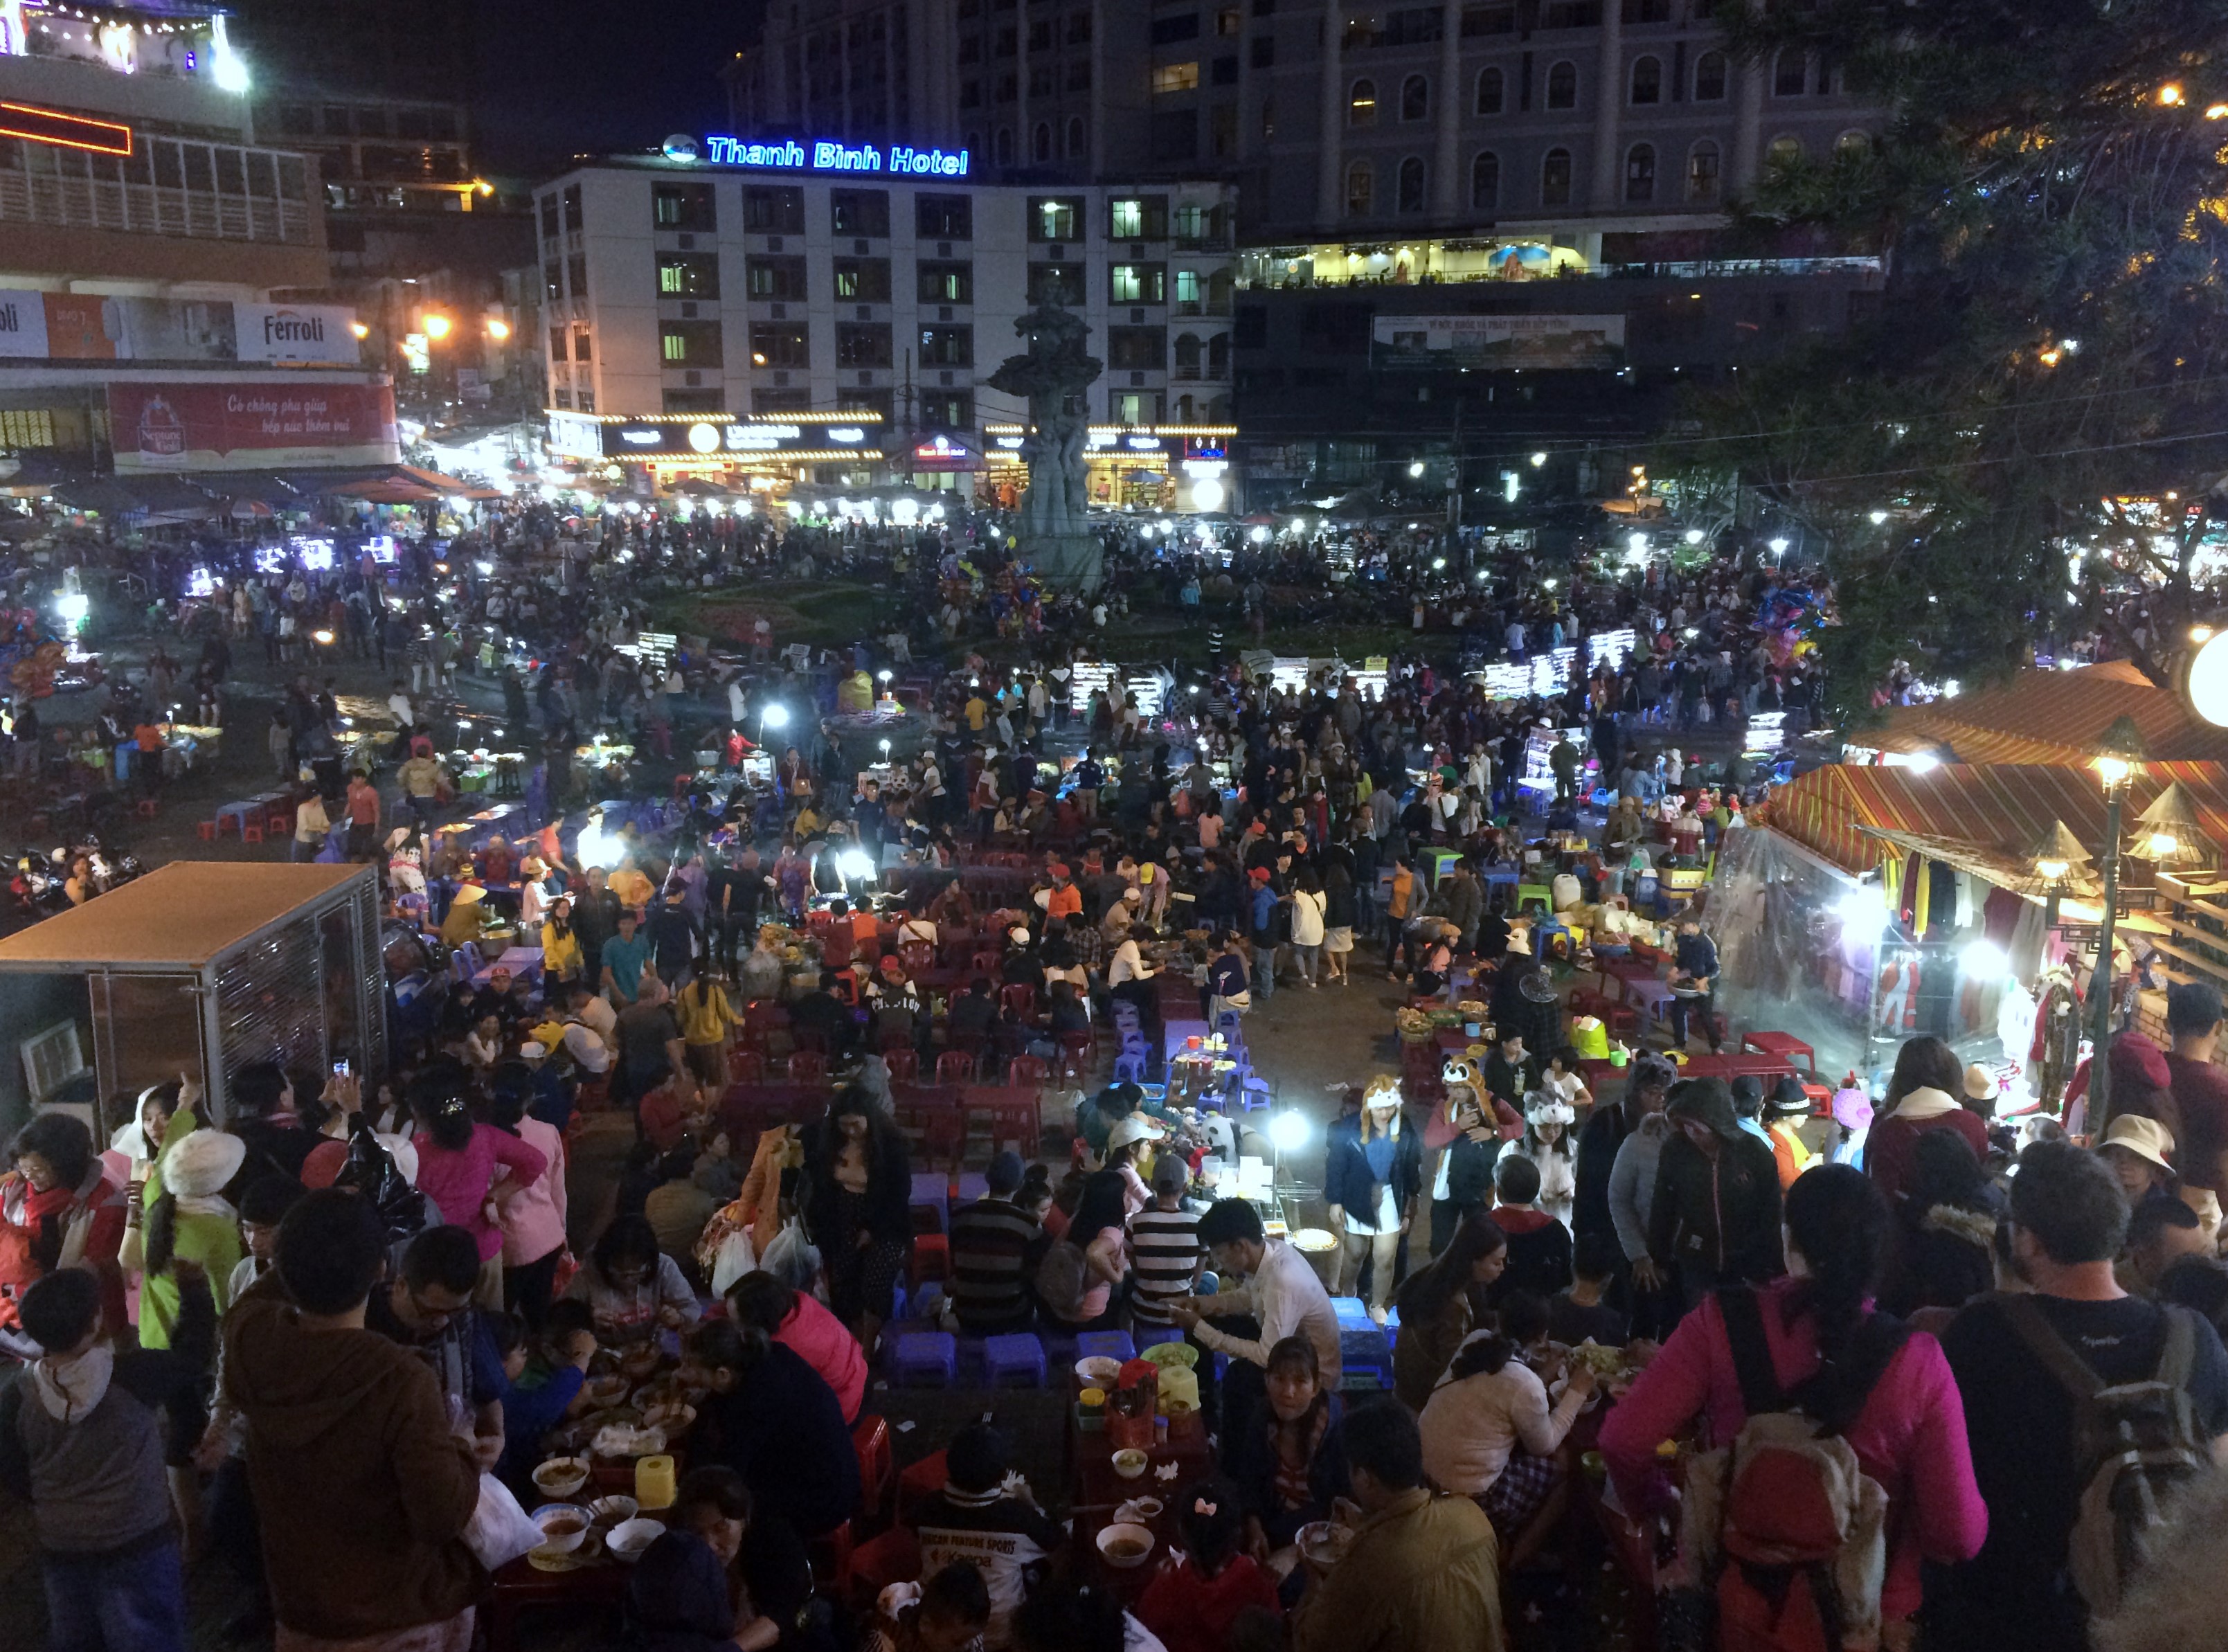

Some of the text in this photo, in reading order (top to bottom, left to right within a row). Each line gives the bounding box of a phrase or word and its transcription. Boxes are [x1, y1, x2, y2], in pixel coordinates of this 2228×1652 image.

[707, 136, 969, 176] Thanh Bình Hotel
[264, 314, 324, 345] Ferroli
[951, 1534, 985, 1549] FEATURE
[987, 1537, 1017, 1555] SPORTS
